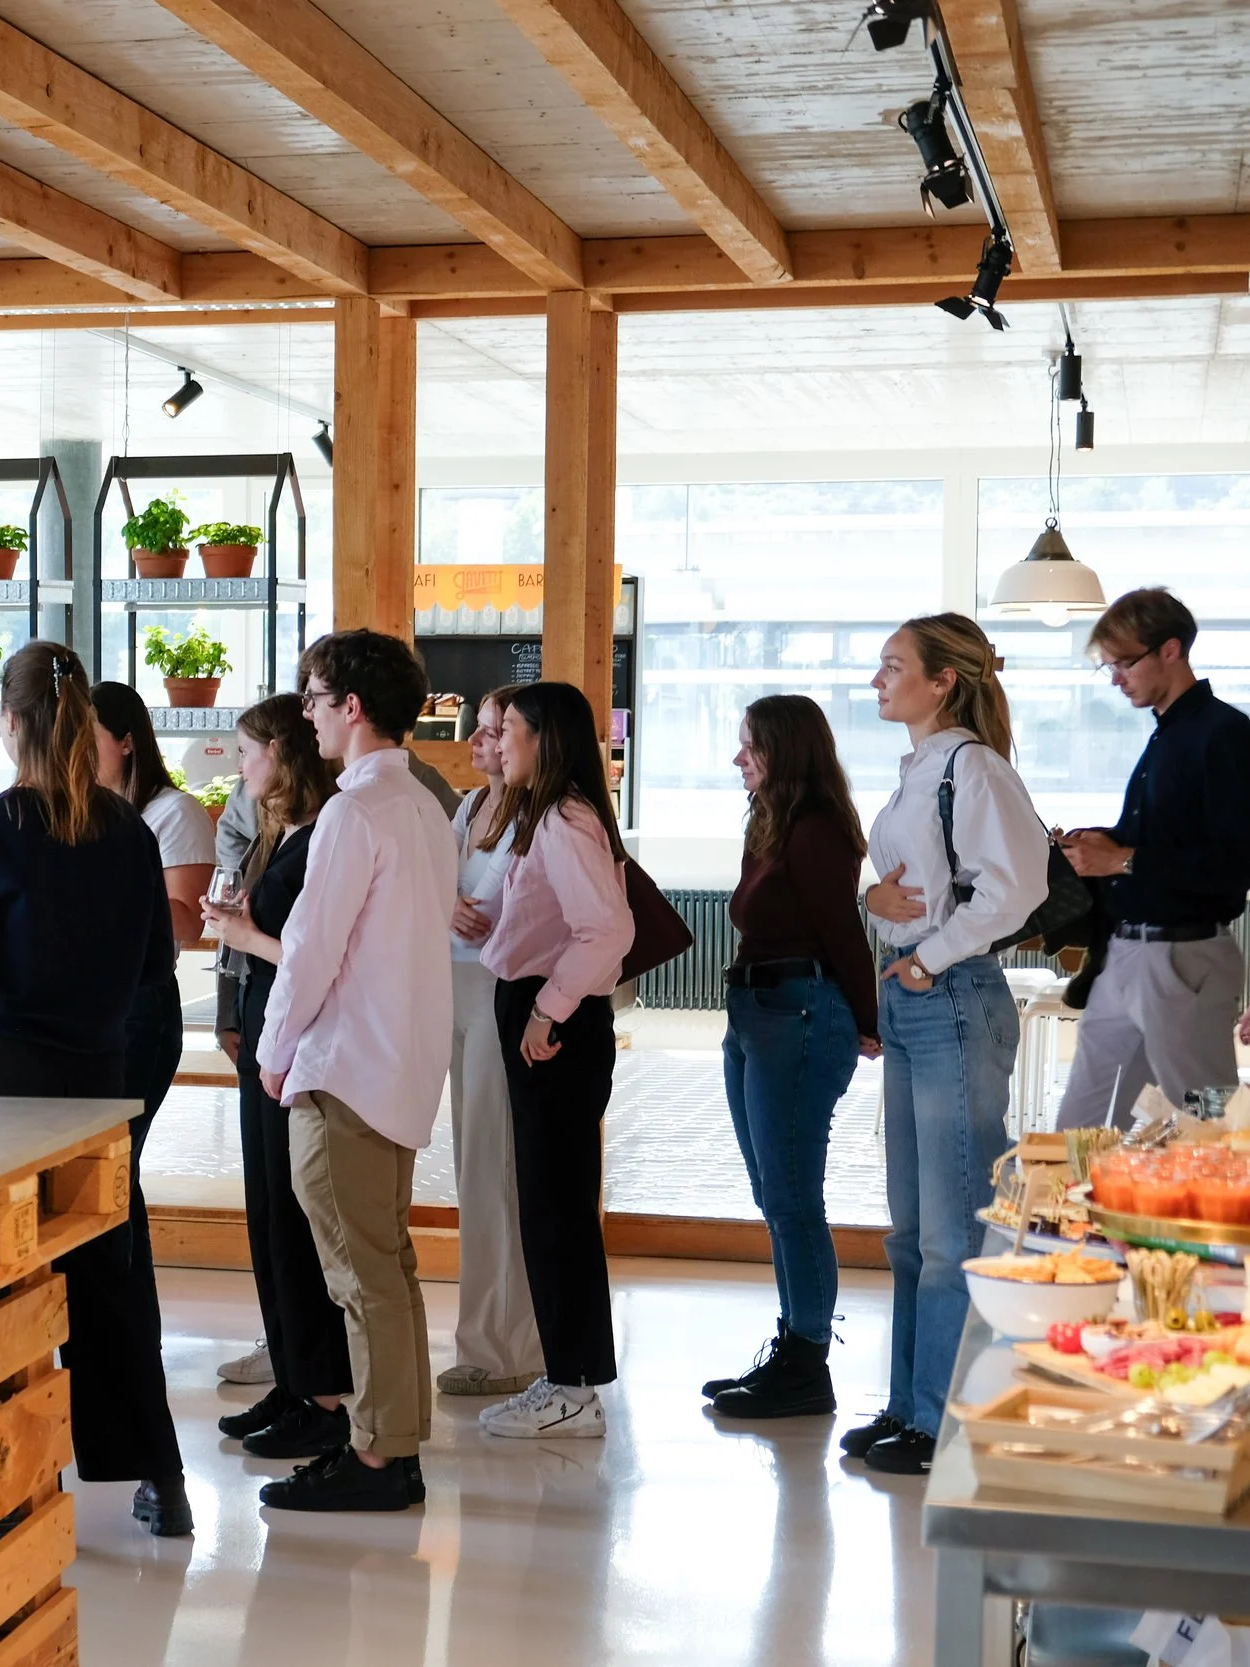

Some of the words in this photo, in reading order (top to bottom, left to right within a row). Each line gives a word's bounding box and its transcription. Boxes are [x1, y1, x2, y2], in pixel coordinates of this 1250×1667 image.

[414, 574, 436, 587] AFI
[518, 573, 543, 587] BAR
[511, 643, 543, 655] CAF
